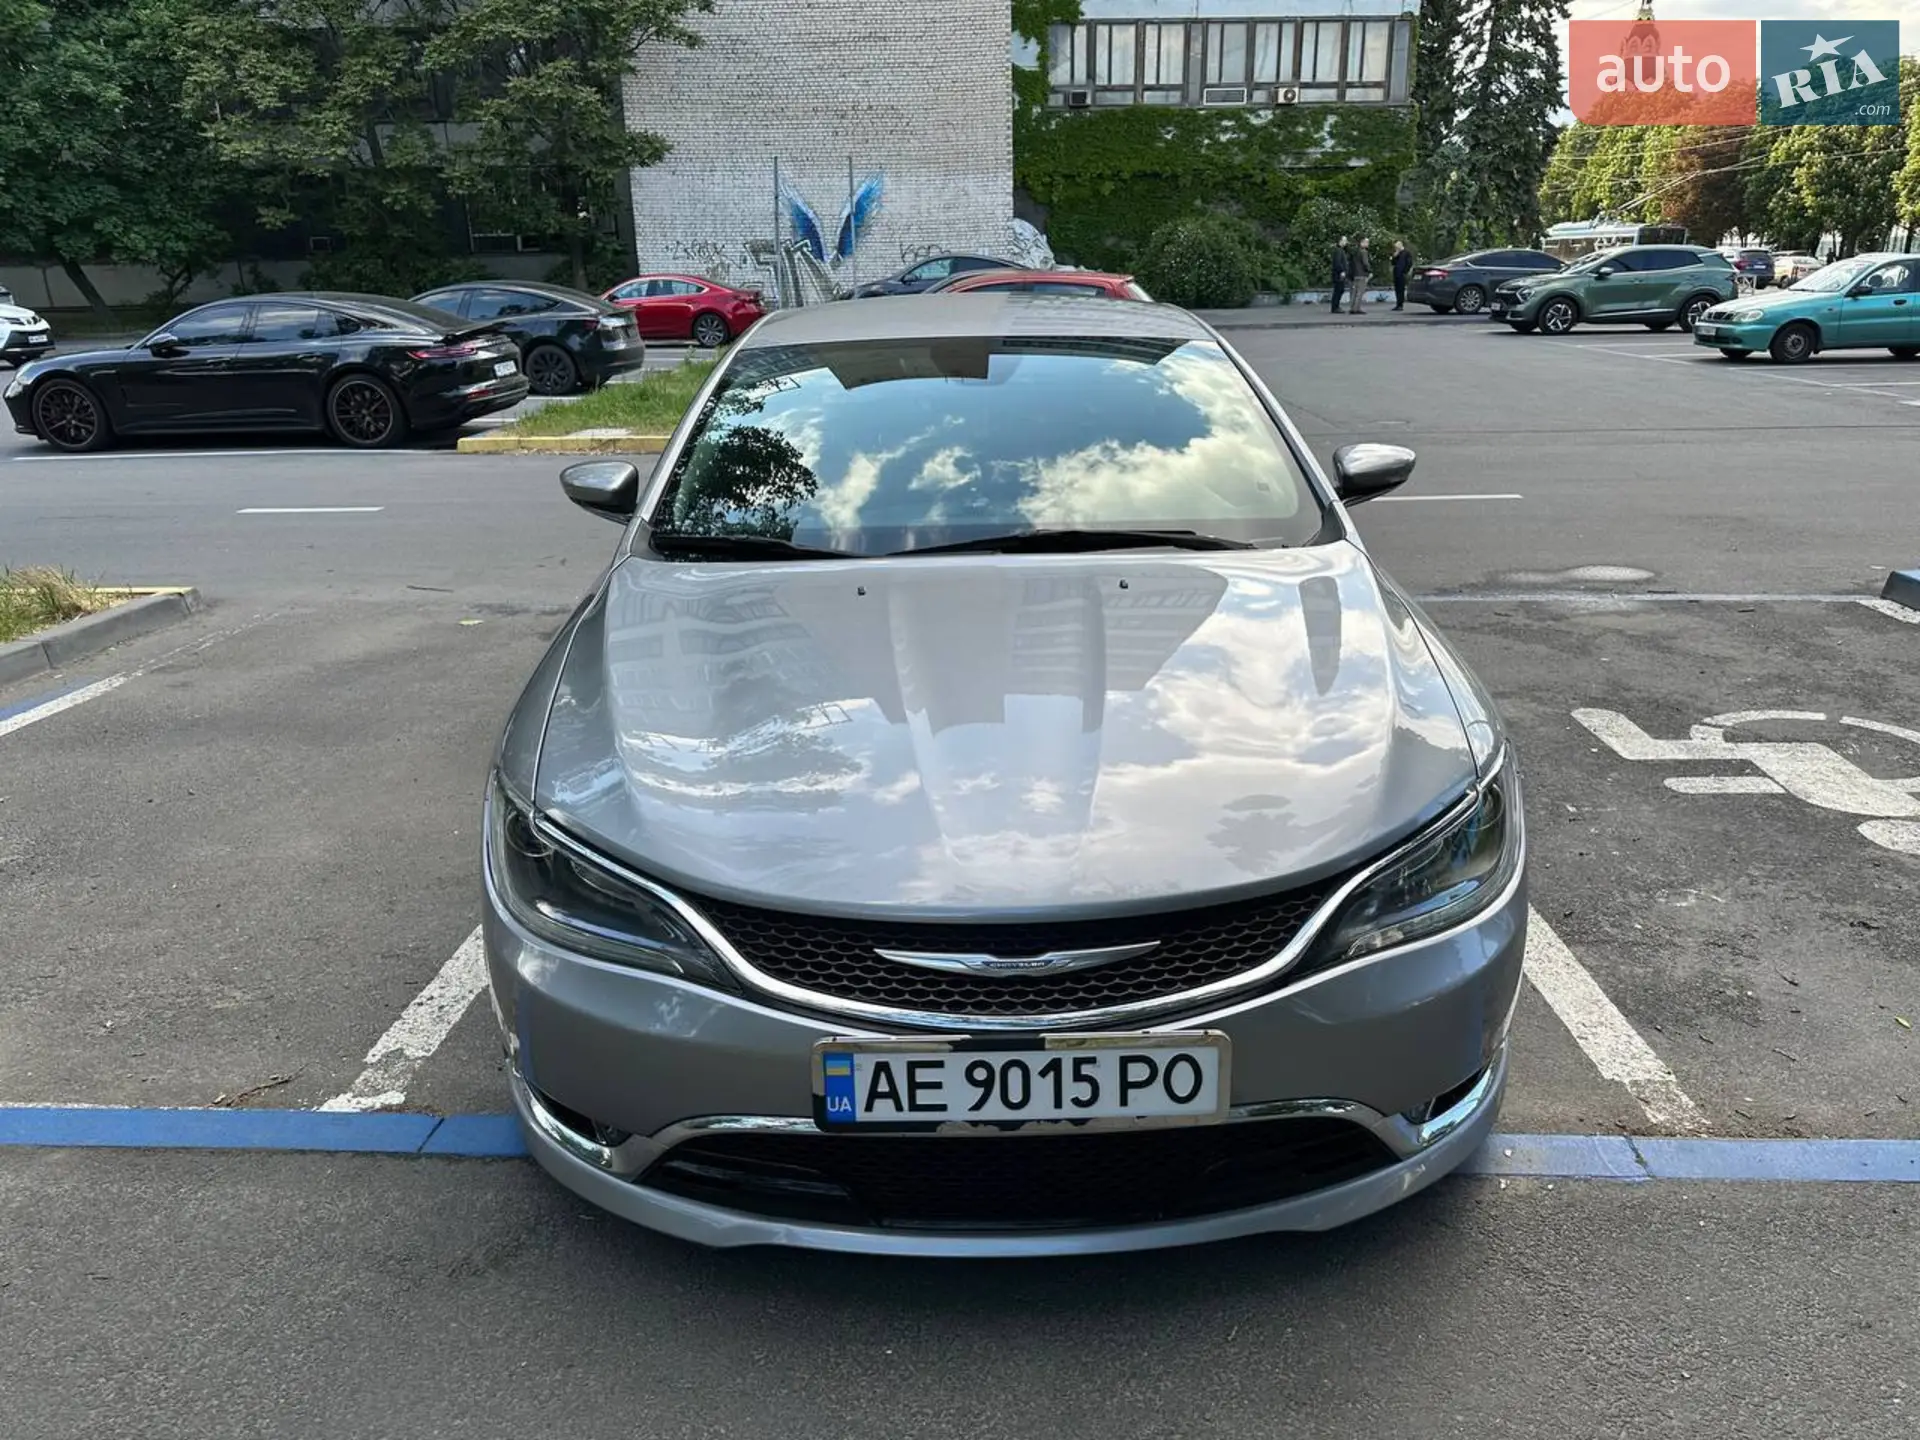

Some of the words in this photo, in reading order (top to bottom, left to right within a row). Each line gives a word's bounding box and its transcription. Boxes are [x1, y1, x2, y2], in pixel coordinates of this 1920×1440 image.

[864, 1060, 948, 1113] AE
[964, 1056, 1100, 1112] 9015
[1118, 1053, 1202, 1108] PO
[827, 1096, 852, 1113] UA
